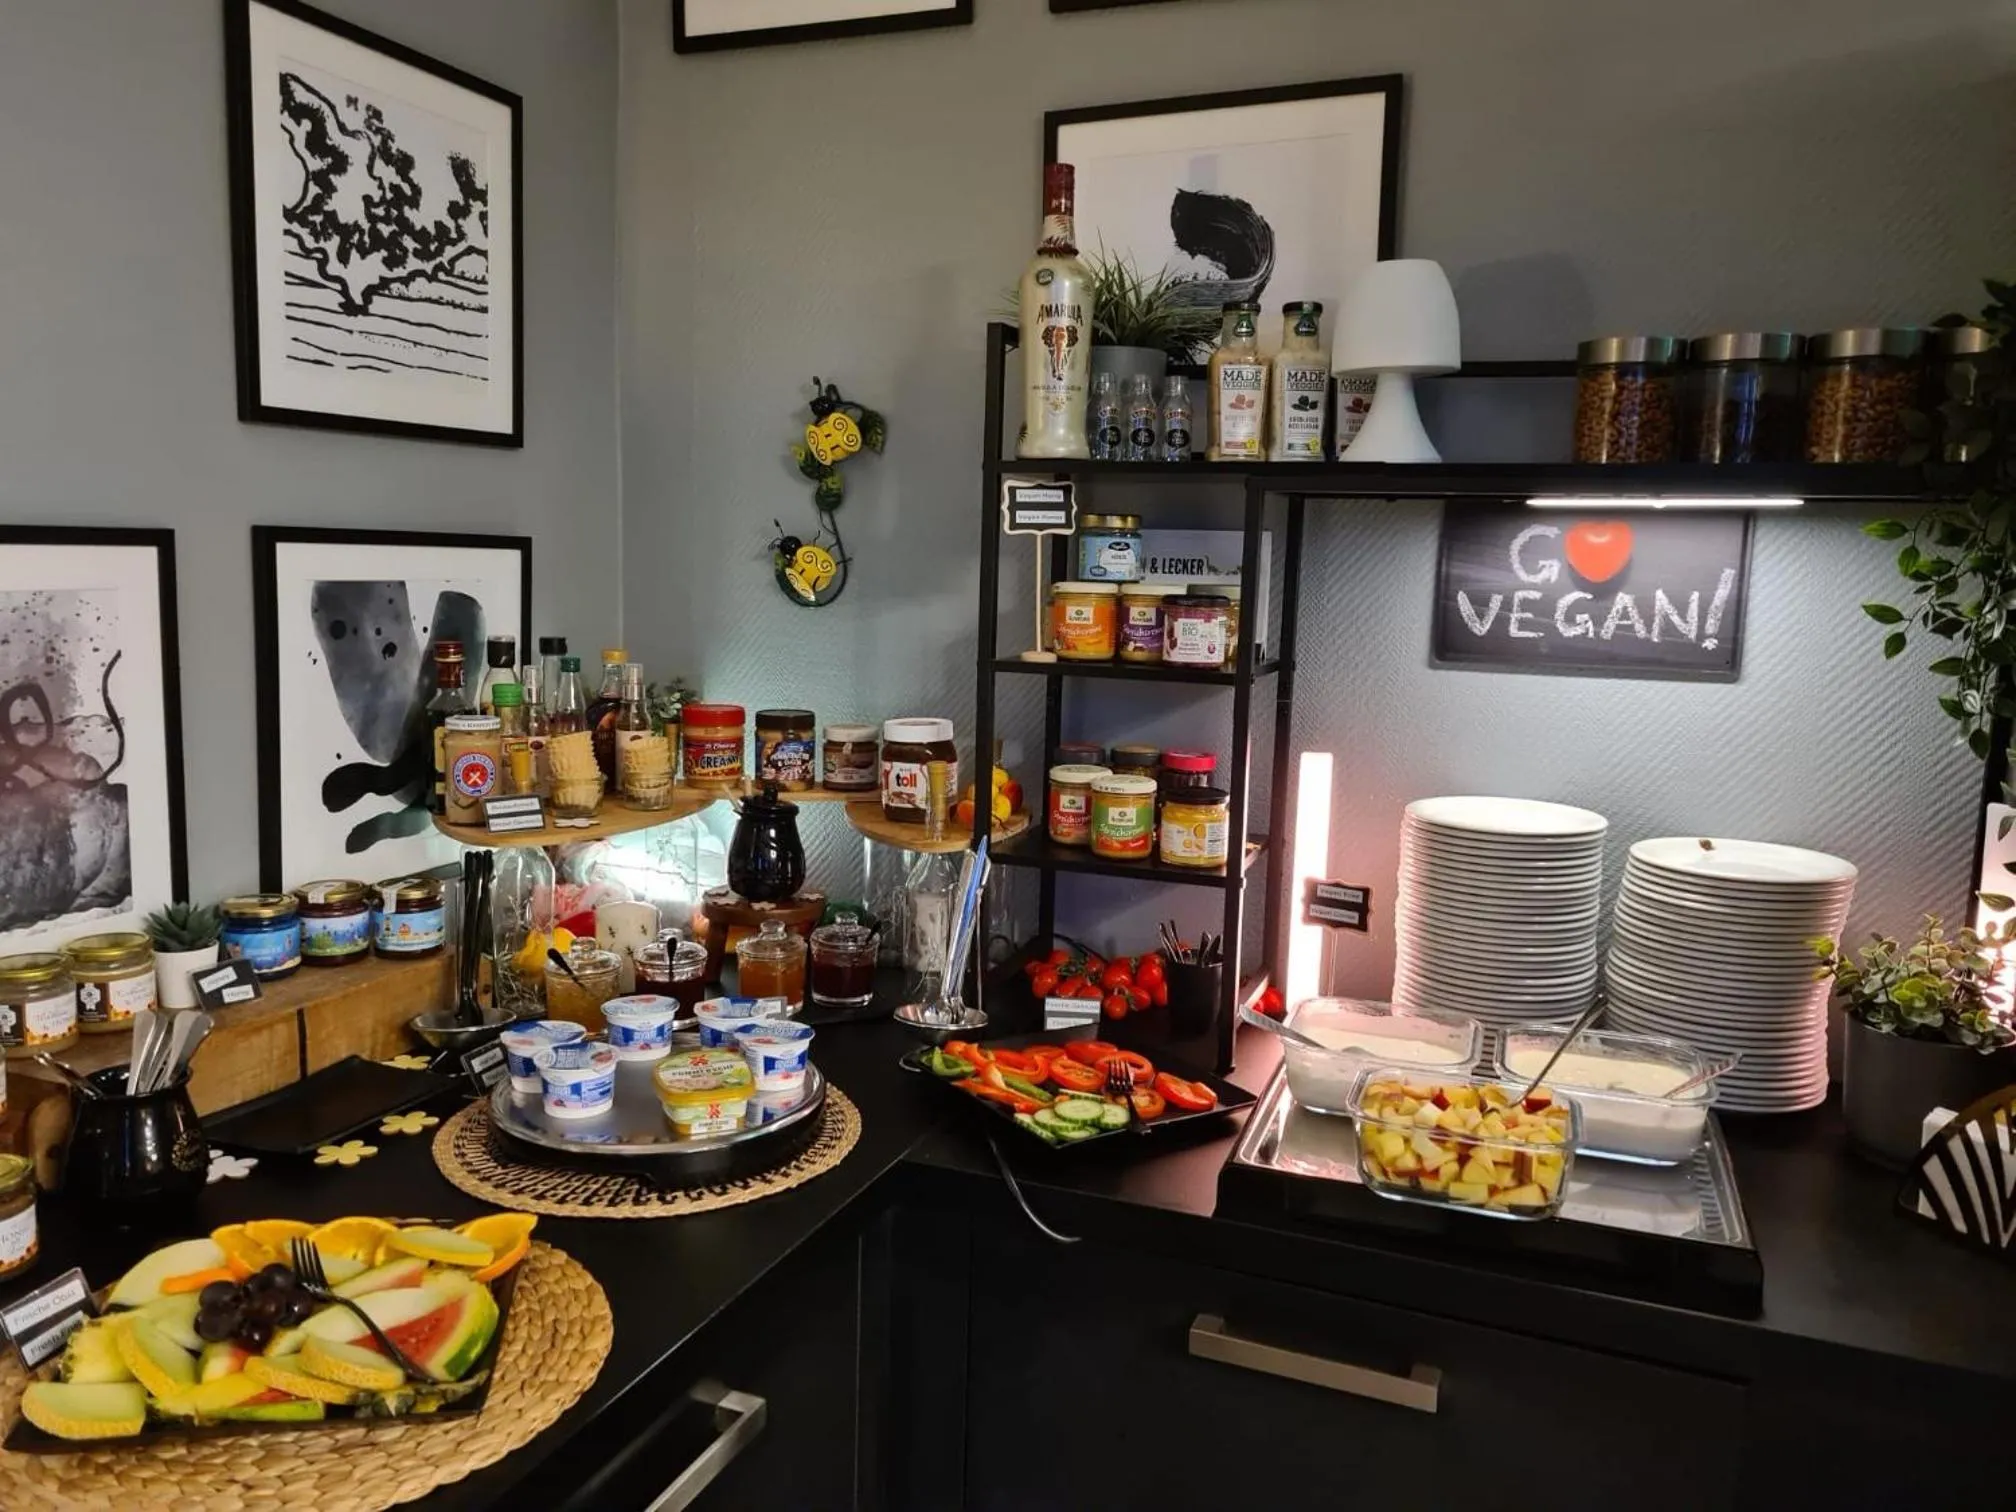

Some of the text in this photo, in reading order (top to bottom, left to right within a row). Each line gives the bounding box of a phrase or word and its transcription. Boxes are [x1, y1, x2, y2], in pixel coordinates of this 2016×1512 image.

[1036, 303, 1083, 327] AMARULA
[1223, 370, 1261, 382] MADE
[1287, 371, 1325, 382] MADE
[1289, 382, 1324, 390] VEGGIES
[1150, 557, 1158, 574] &
[1162, 557, 1204, 576] LECKER
[1456, 568, 1736, 651] VEGAN!
[896, 773, 917, 787] toll
